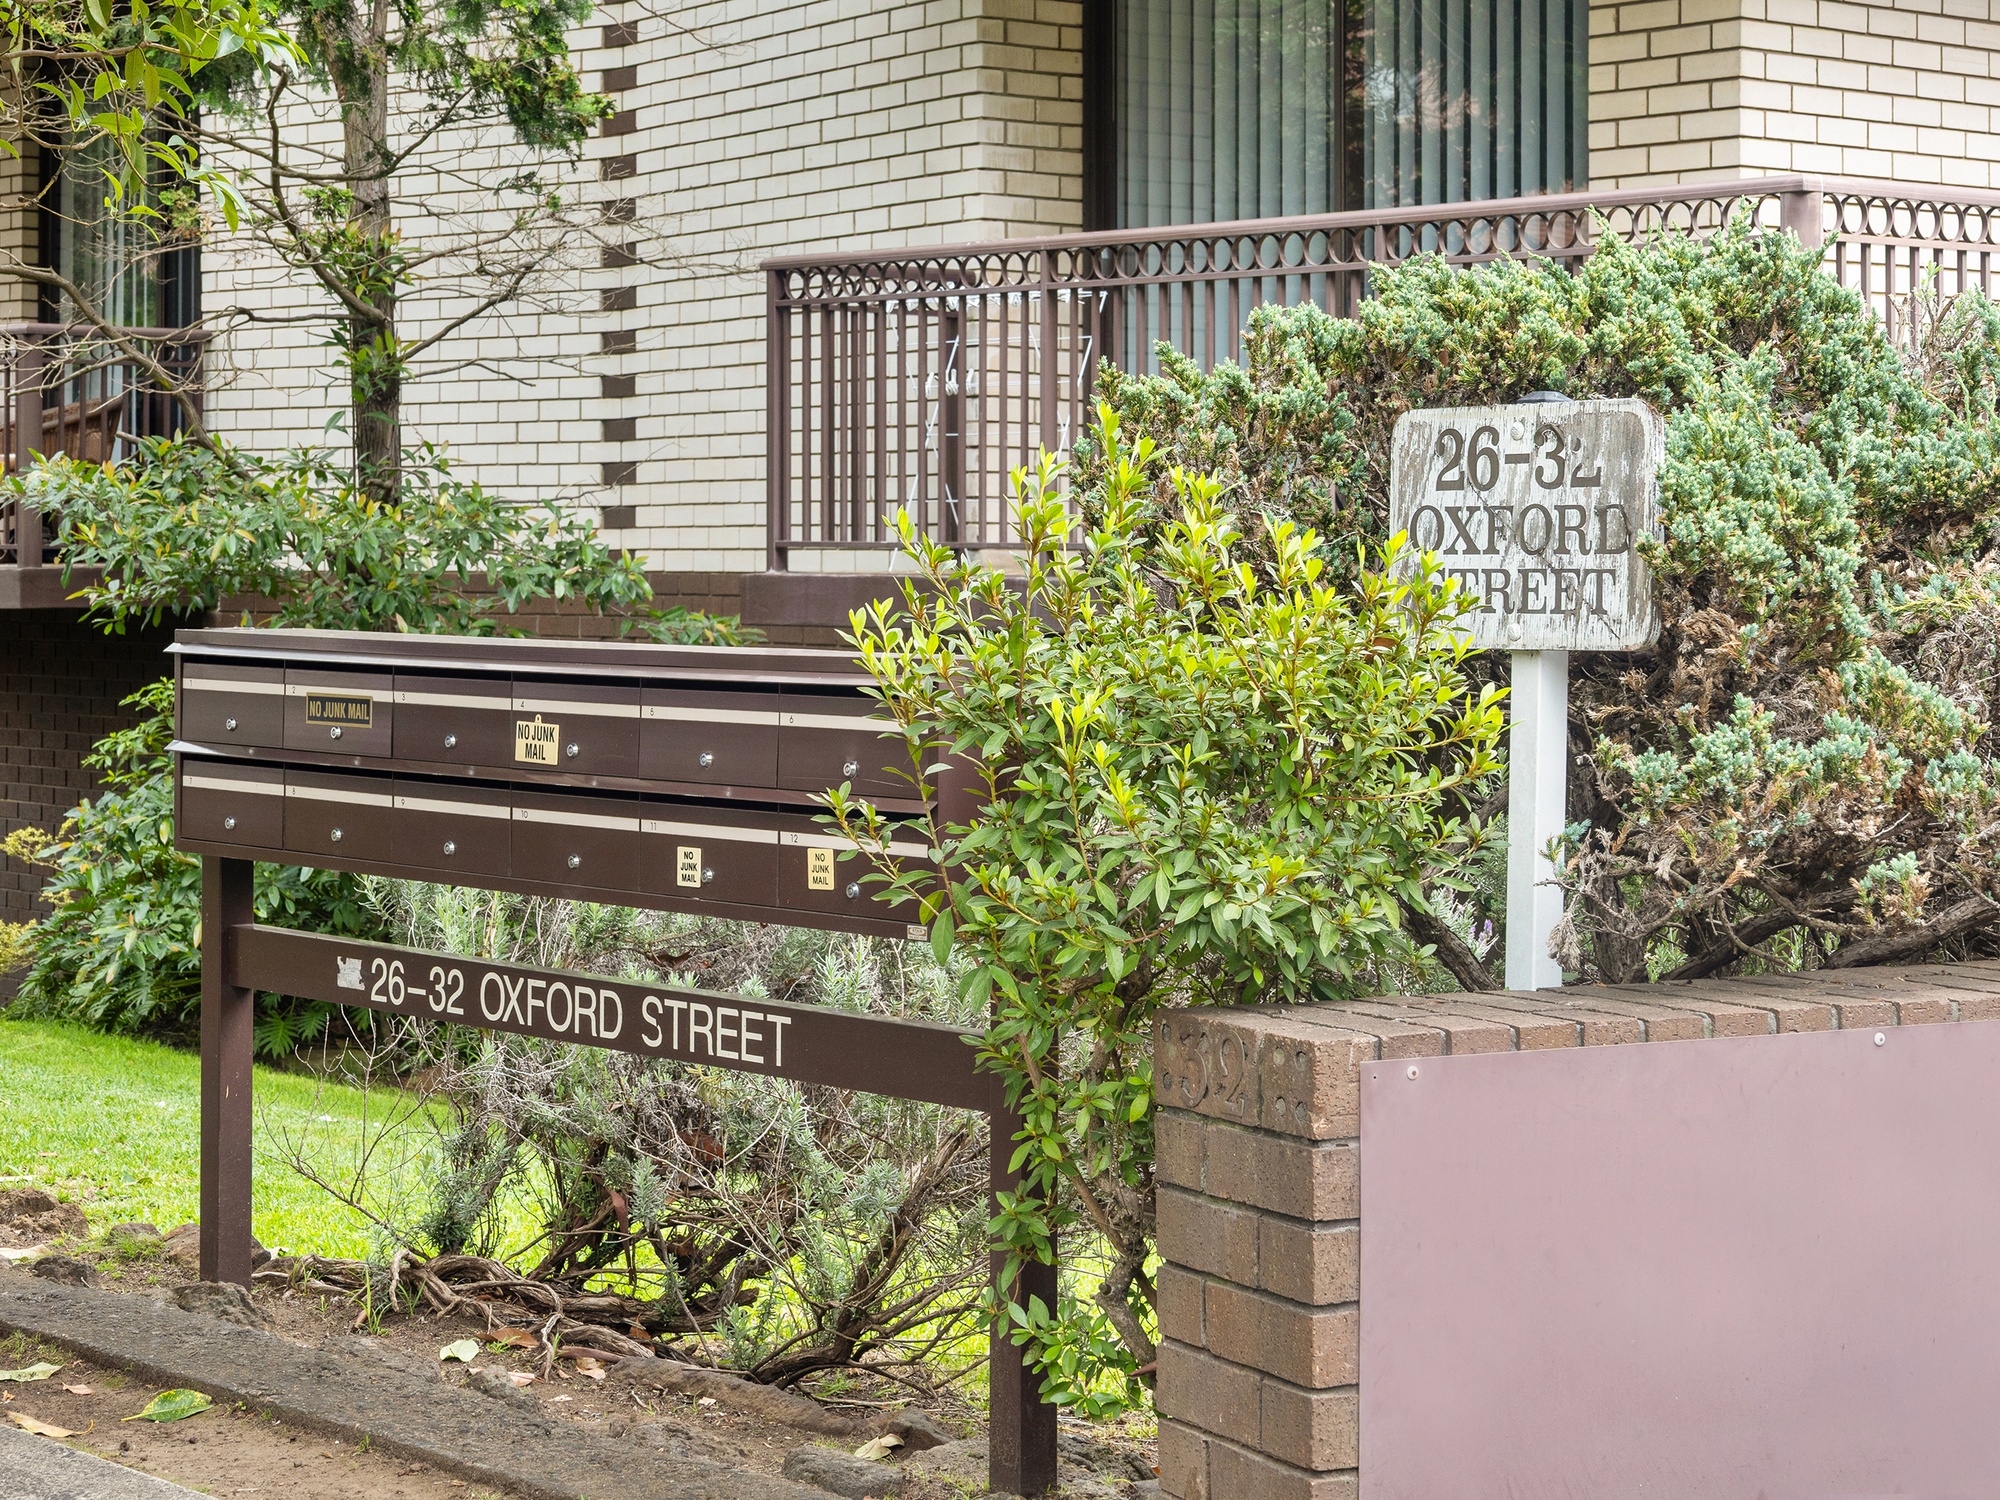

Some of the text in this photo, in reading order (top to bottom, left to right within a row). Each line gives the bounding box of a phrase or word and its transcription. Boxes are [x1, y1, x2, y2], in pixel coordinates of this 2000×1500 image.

[1435, 425, 1602, 492] 26-32
[1409, 503, 1632, 556] OXFORD
[291, 686, 297, 694] 2
[401, 693, 406, 702] 3
[520, 700, 526, 708] 4
[309, 700, 370, 720] NO JUNK MAIL
[649, 707, 655, 717] 5
[788, 714, 795, 724] 6
[517, 723, 556, 743] NO JUNK
[524, 742, 547, 761] MAIL
[291, 787, 297, 796] 8
[400, 798, 406, 807] 9
[520, 809, 529, 819] 10
[650, 821, 657, 831] 11
[790, 833, 799, 844] 12
[683, 851, 694, 860] NO
[814, 852, 826, 863] NO
[680, 862, 698, 872] JUNK
[811, 864, 830, 874] JUNK
[681, 873, 697, 883] MAIL
[812, 875, 829, 886] MAIL
[370, 957, 792, 1068] 26-32 OXFORD STREET
